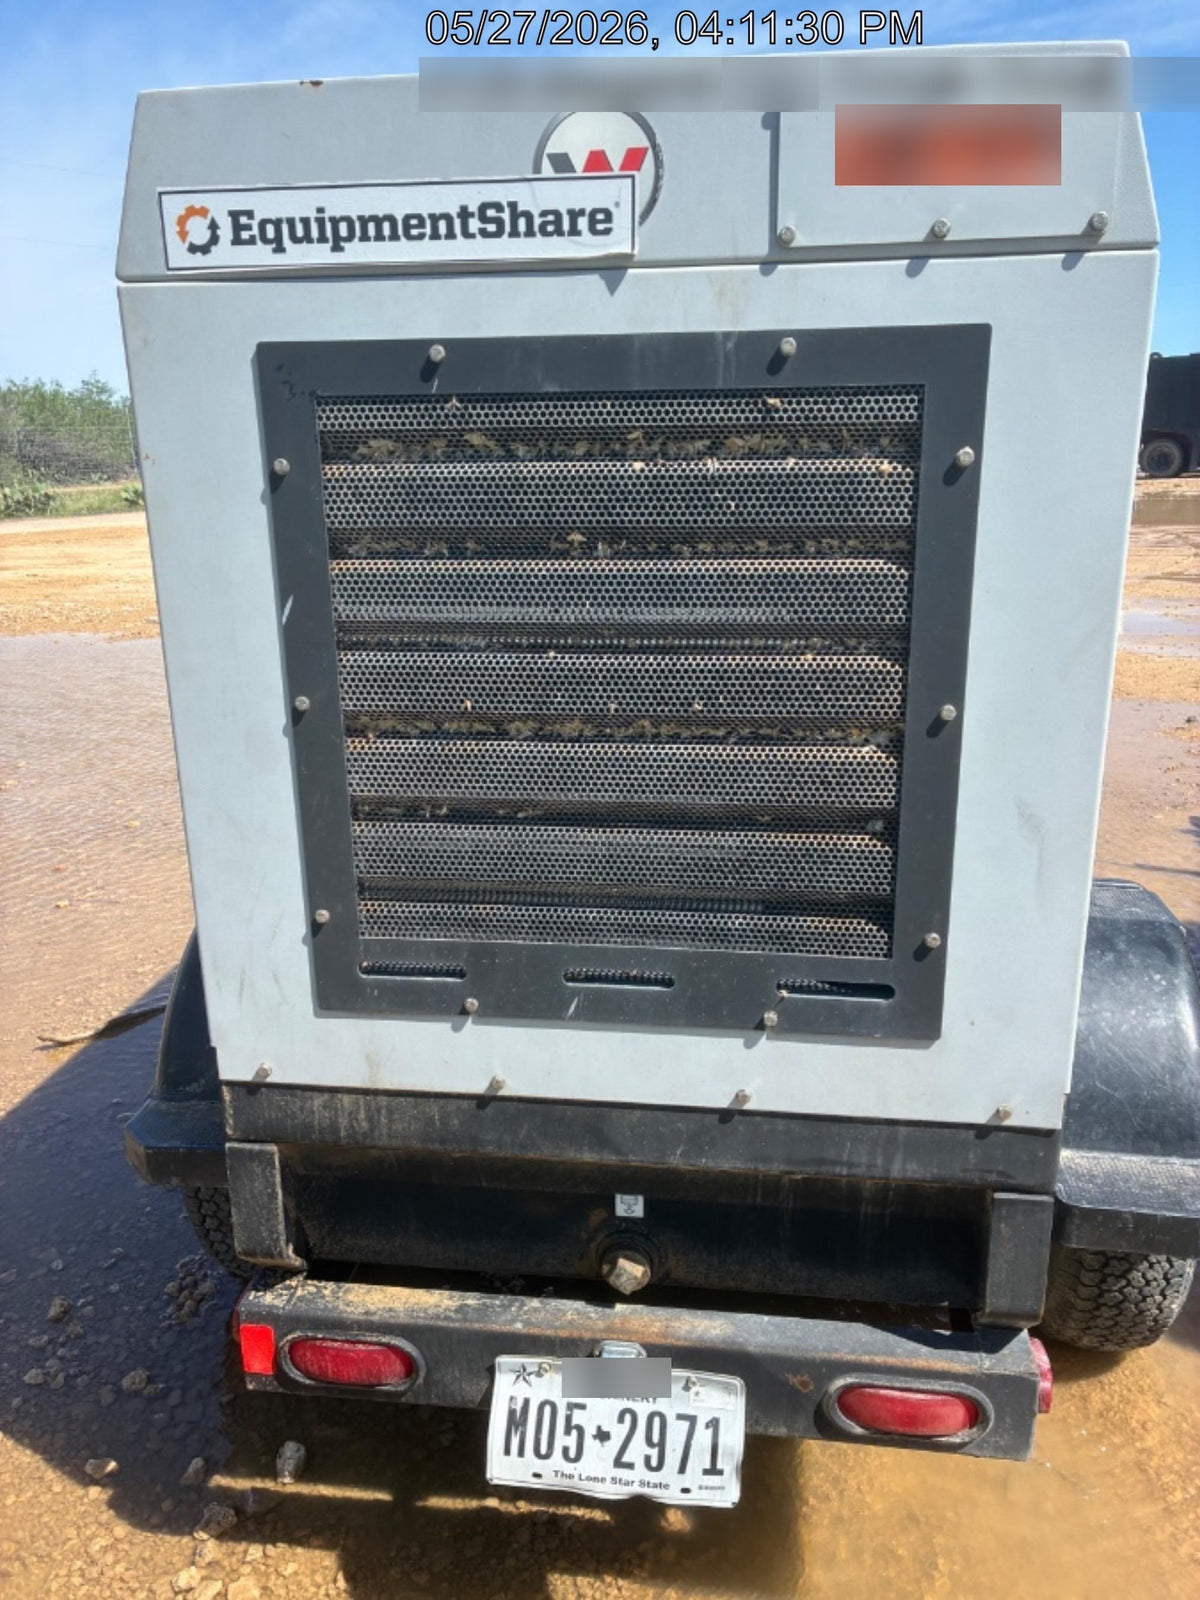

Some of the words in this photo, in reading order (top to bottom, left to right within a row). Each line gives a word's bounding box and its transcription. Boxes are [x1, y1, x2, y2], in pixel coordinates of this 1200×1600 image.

[227, 201, 614, 253] EquipmentShare
[552, 1469, 576, 1481] The
[578, 1473, 608, 1484] Lone
[610, 1476, 636, 1488] Star
[638, 1478, 671, 1491] State
